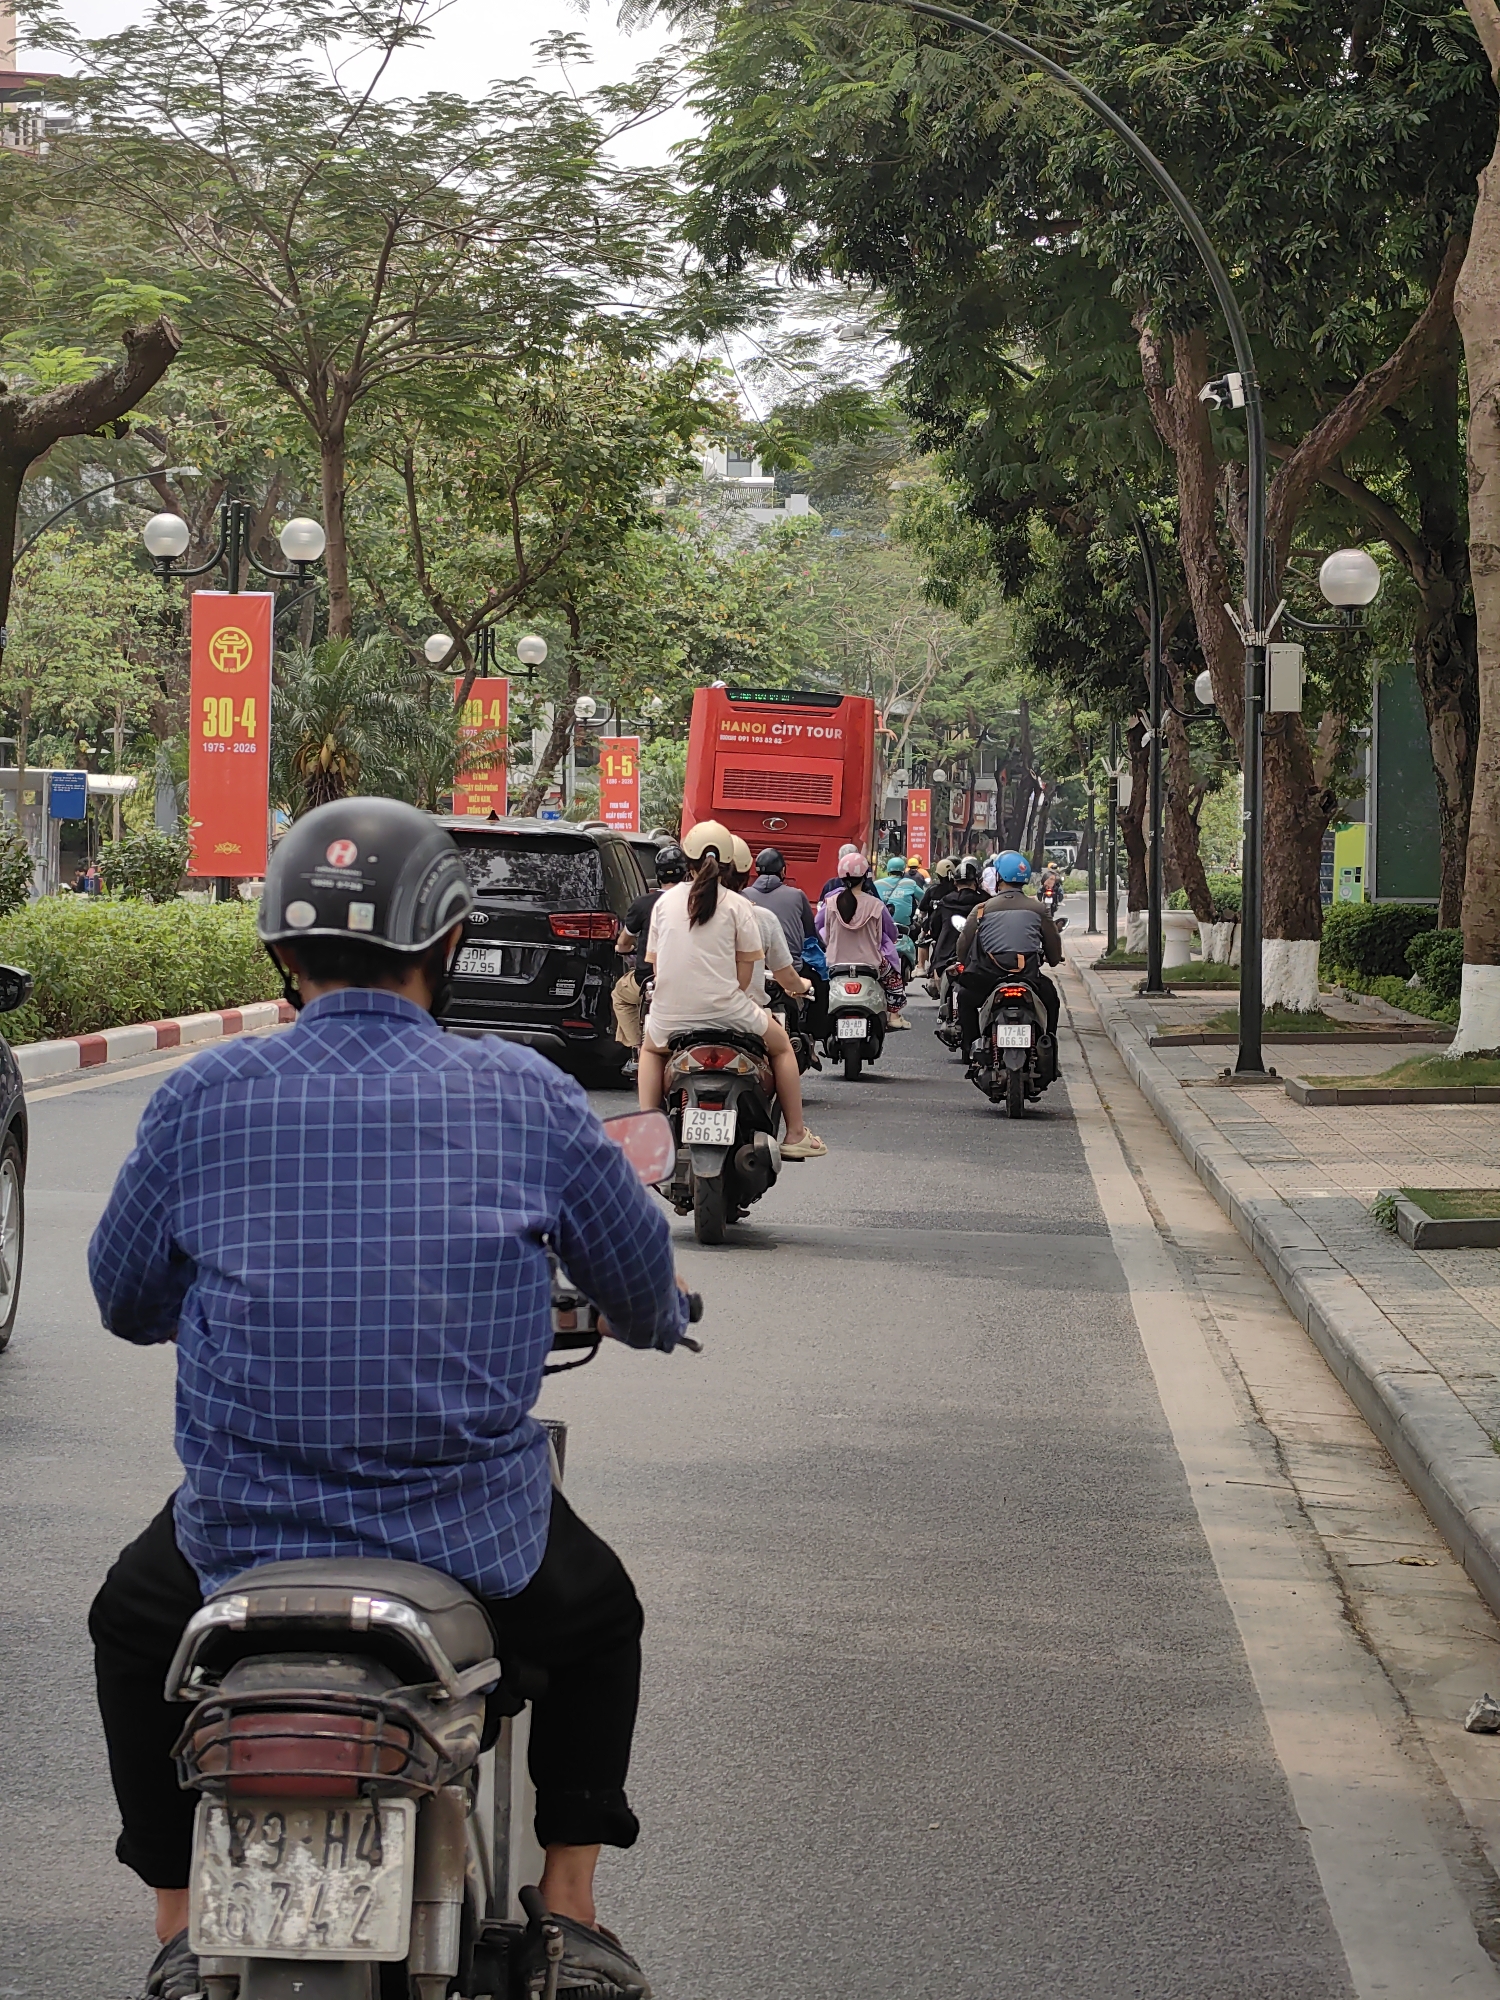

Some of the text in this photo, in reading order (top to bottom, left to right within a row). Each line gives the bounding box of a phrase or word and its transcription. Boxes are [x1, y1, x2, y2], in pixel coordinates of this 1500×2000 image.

[203, 697, 256, 738] 30-4
[721, 720, 843, 740] HANOI CITY TOUR
[203, 743, 225, 753] 1975
[233, 743, 257, 753] 2026
[606, 755, 633, 777] 1-5
[911, 799, 927, 812] 1-5
[468, 914, 485, 923] KIA
[463, 949, 487, 960] 30H
[999, 1036, 1029, 1046] 066.38
[691, 1111, 728, 1126] 29-C1
[686, 1127, 730, 1142] 696.34
